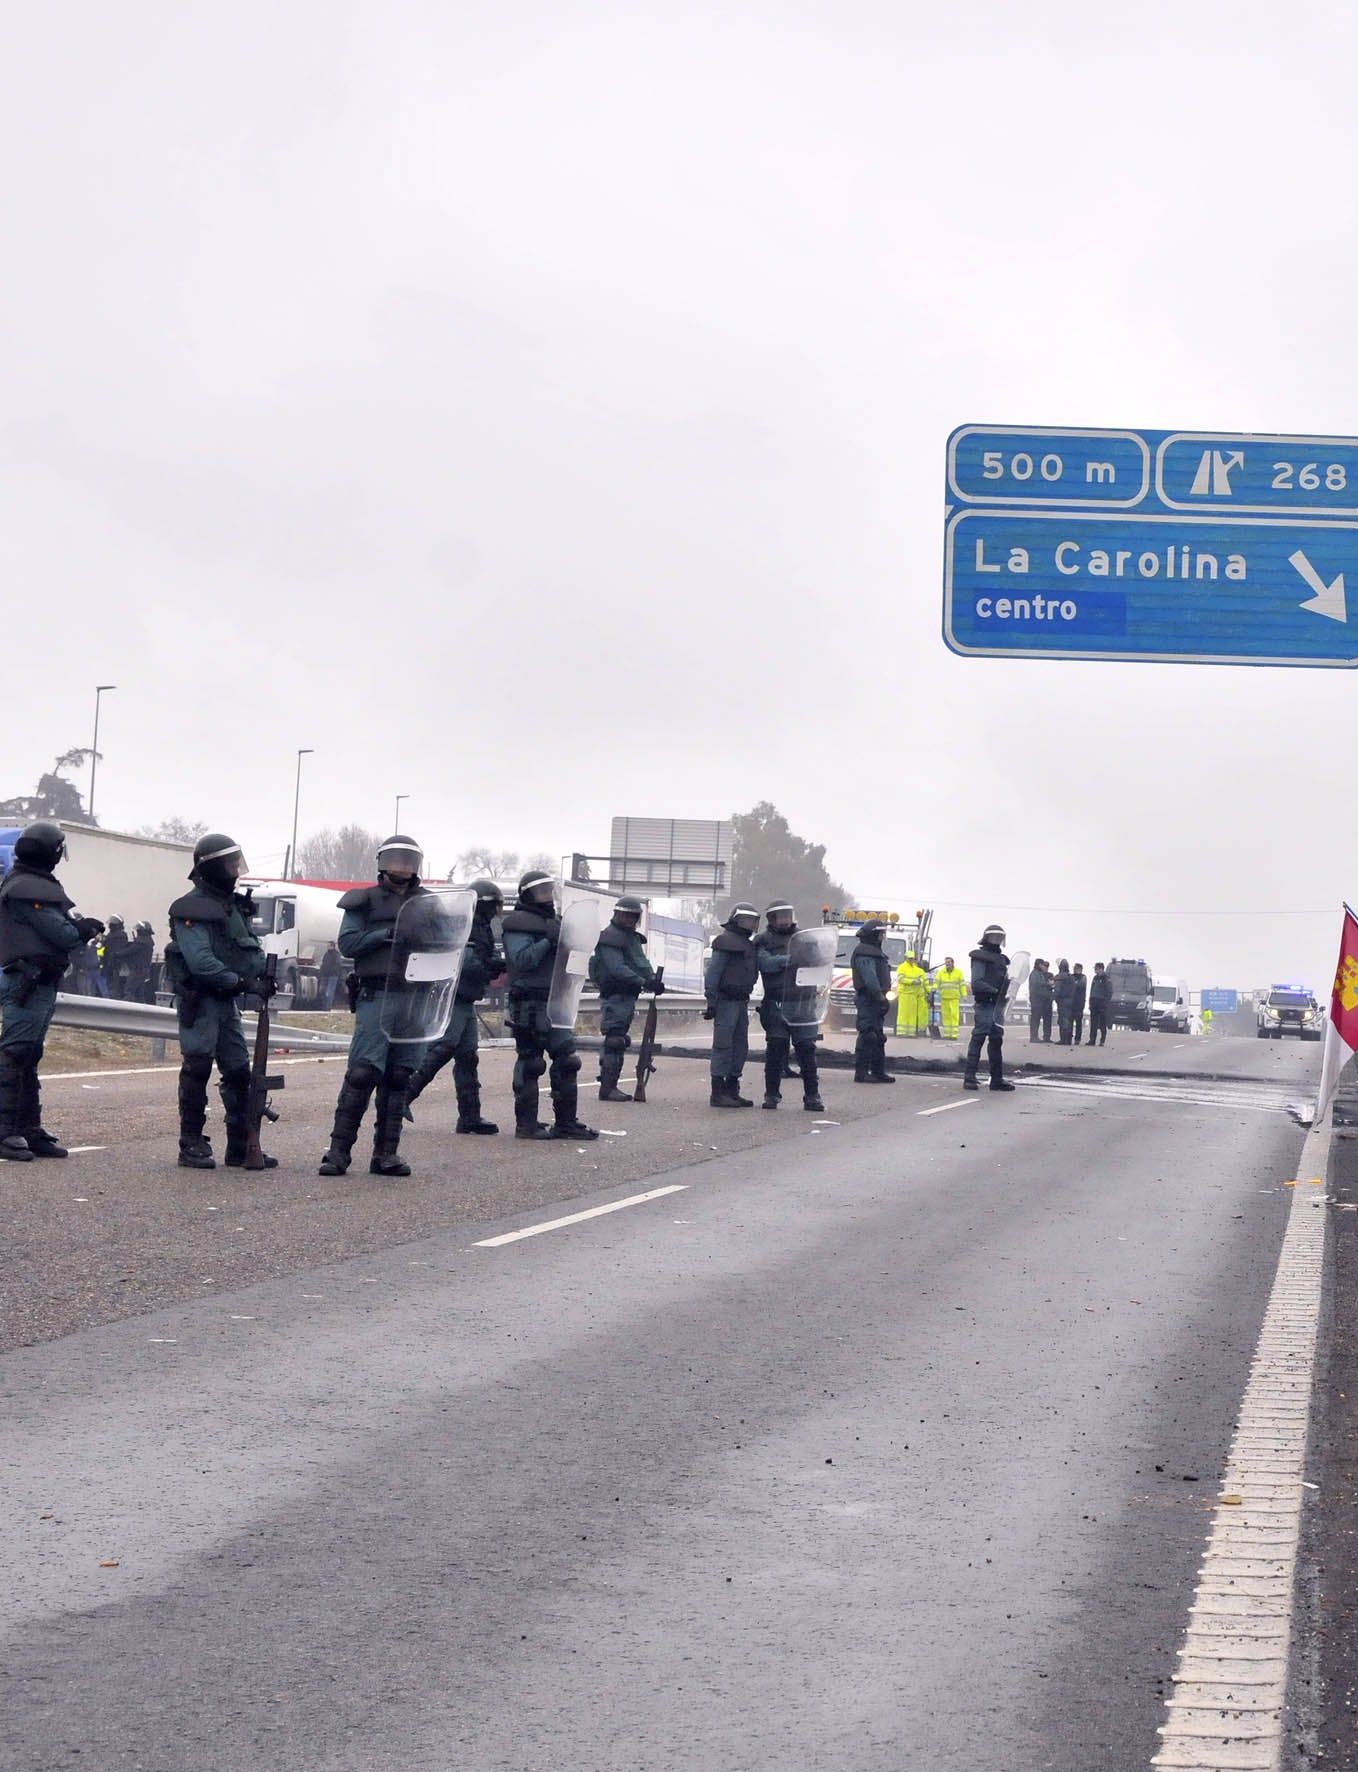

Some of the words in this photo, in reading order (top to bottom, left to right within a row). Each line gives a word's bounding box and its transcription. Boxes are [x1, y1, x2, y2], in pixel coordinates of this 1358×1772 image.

[982, 452, 1064, 482] 500
[1086, 461, 1116, 484] m
[1271, 462, 1348, 491] 268
[975, 538, 1029, 574] La
[1054, 541, 1247, 580] Carolina
[975, 593, 1078, 621] centro
